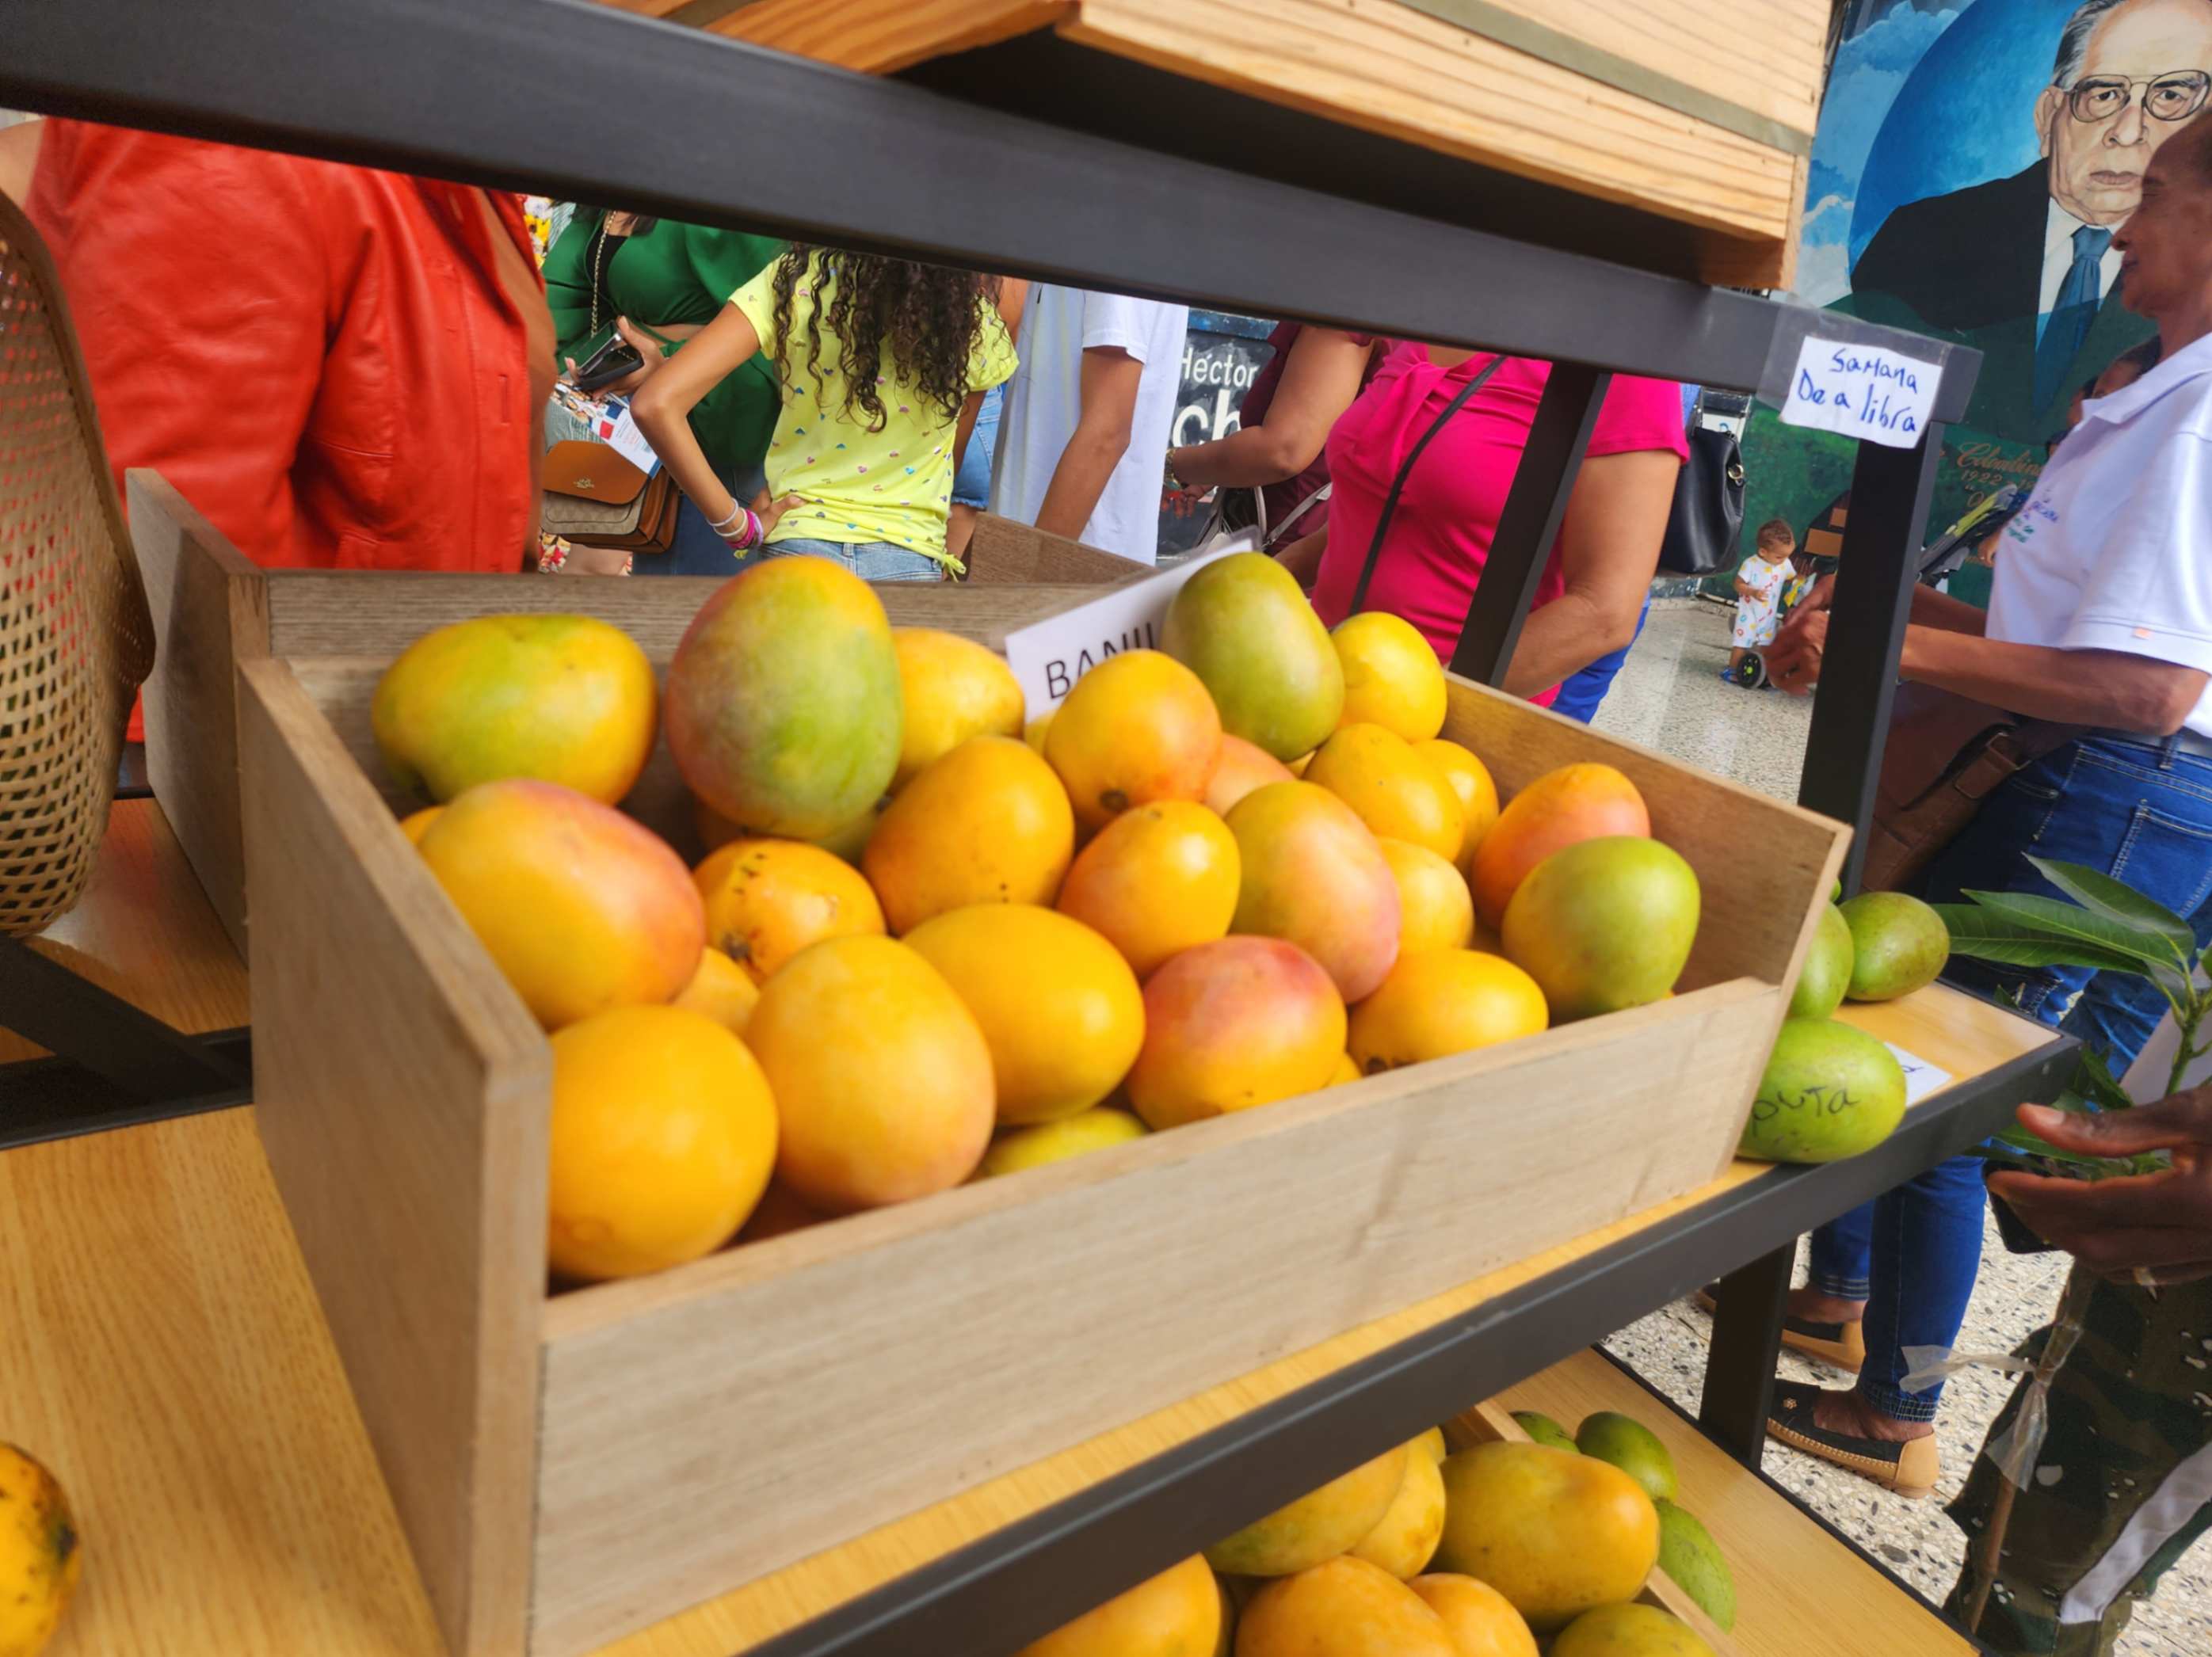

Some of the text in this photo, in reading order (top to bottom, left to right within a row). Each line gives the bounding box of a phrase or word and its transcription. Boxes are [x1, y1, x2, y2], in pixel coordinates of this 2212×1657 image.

[1798, 368, 1916, 432] De a libra
